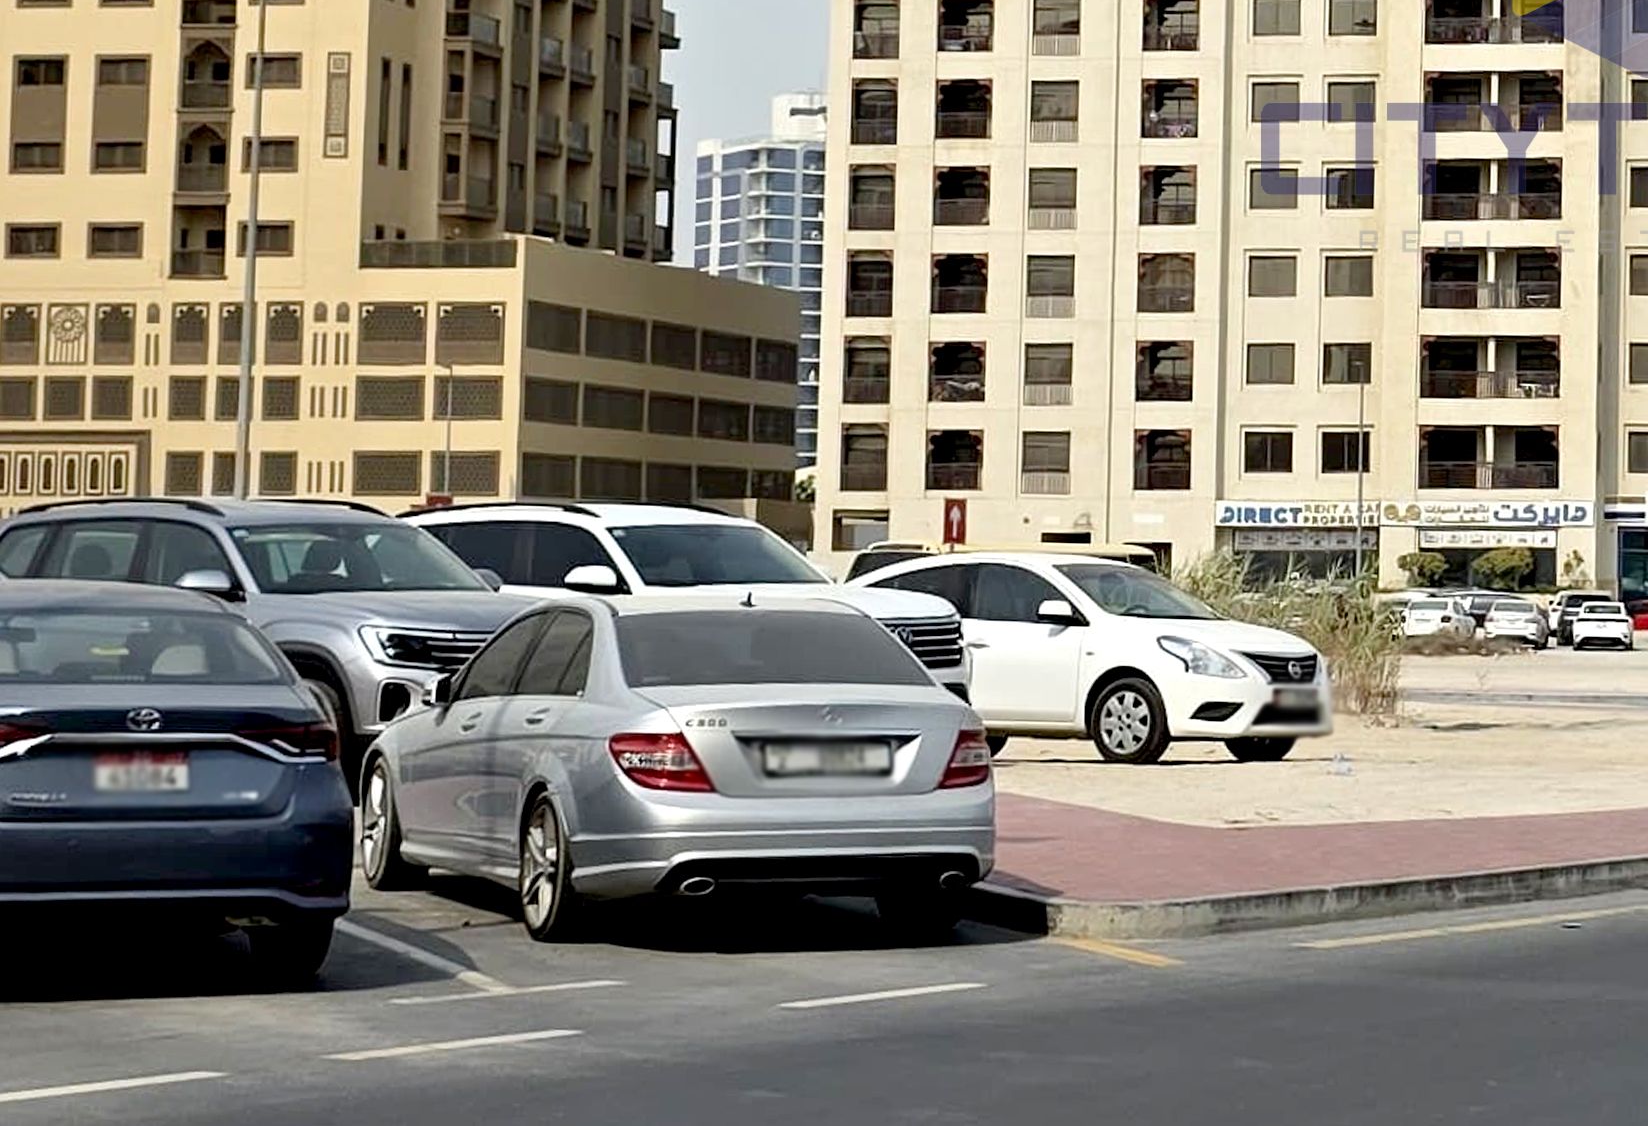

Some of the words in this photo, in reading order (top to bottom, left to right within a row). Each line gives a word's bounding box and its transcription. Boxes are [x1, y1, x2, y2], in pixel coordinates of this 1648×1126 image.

[1219, 506, 1302, 524] DIRECT
[1304, 504, 1339, 514] RENT
[1343, 504, 1352, 514] A
